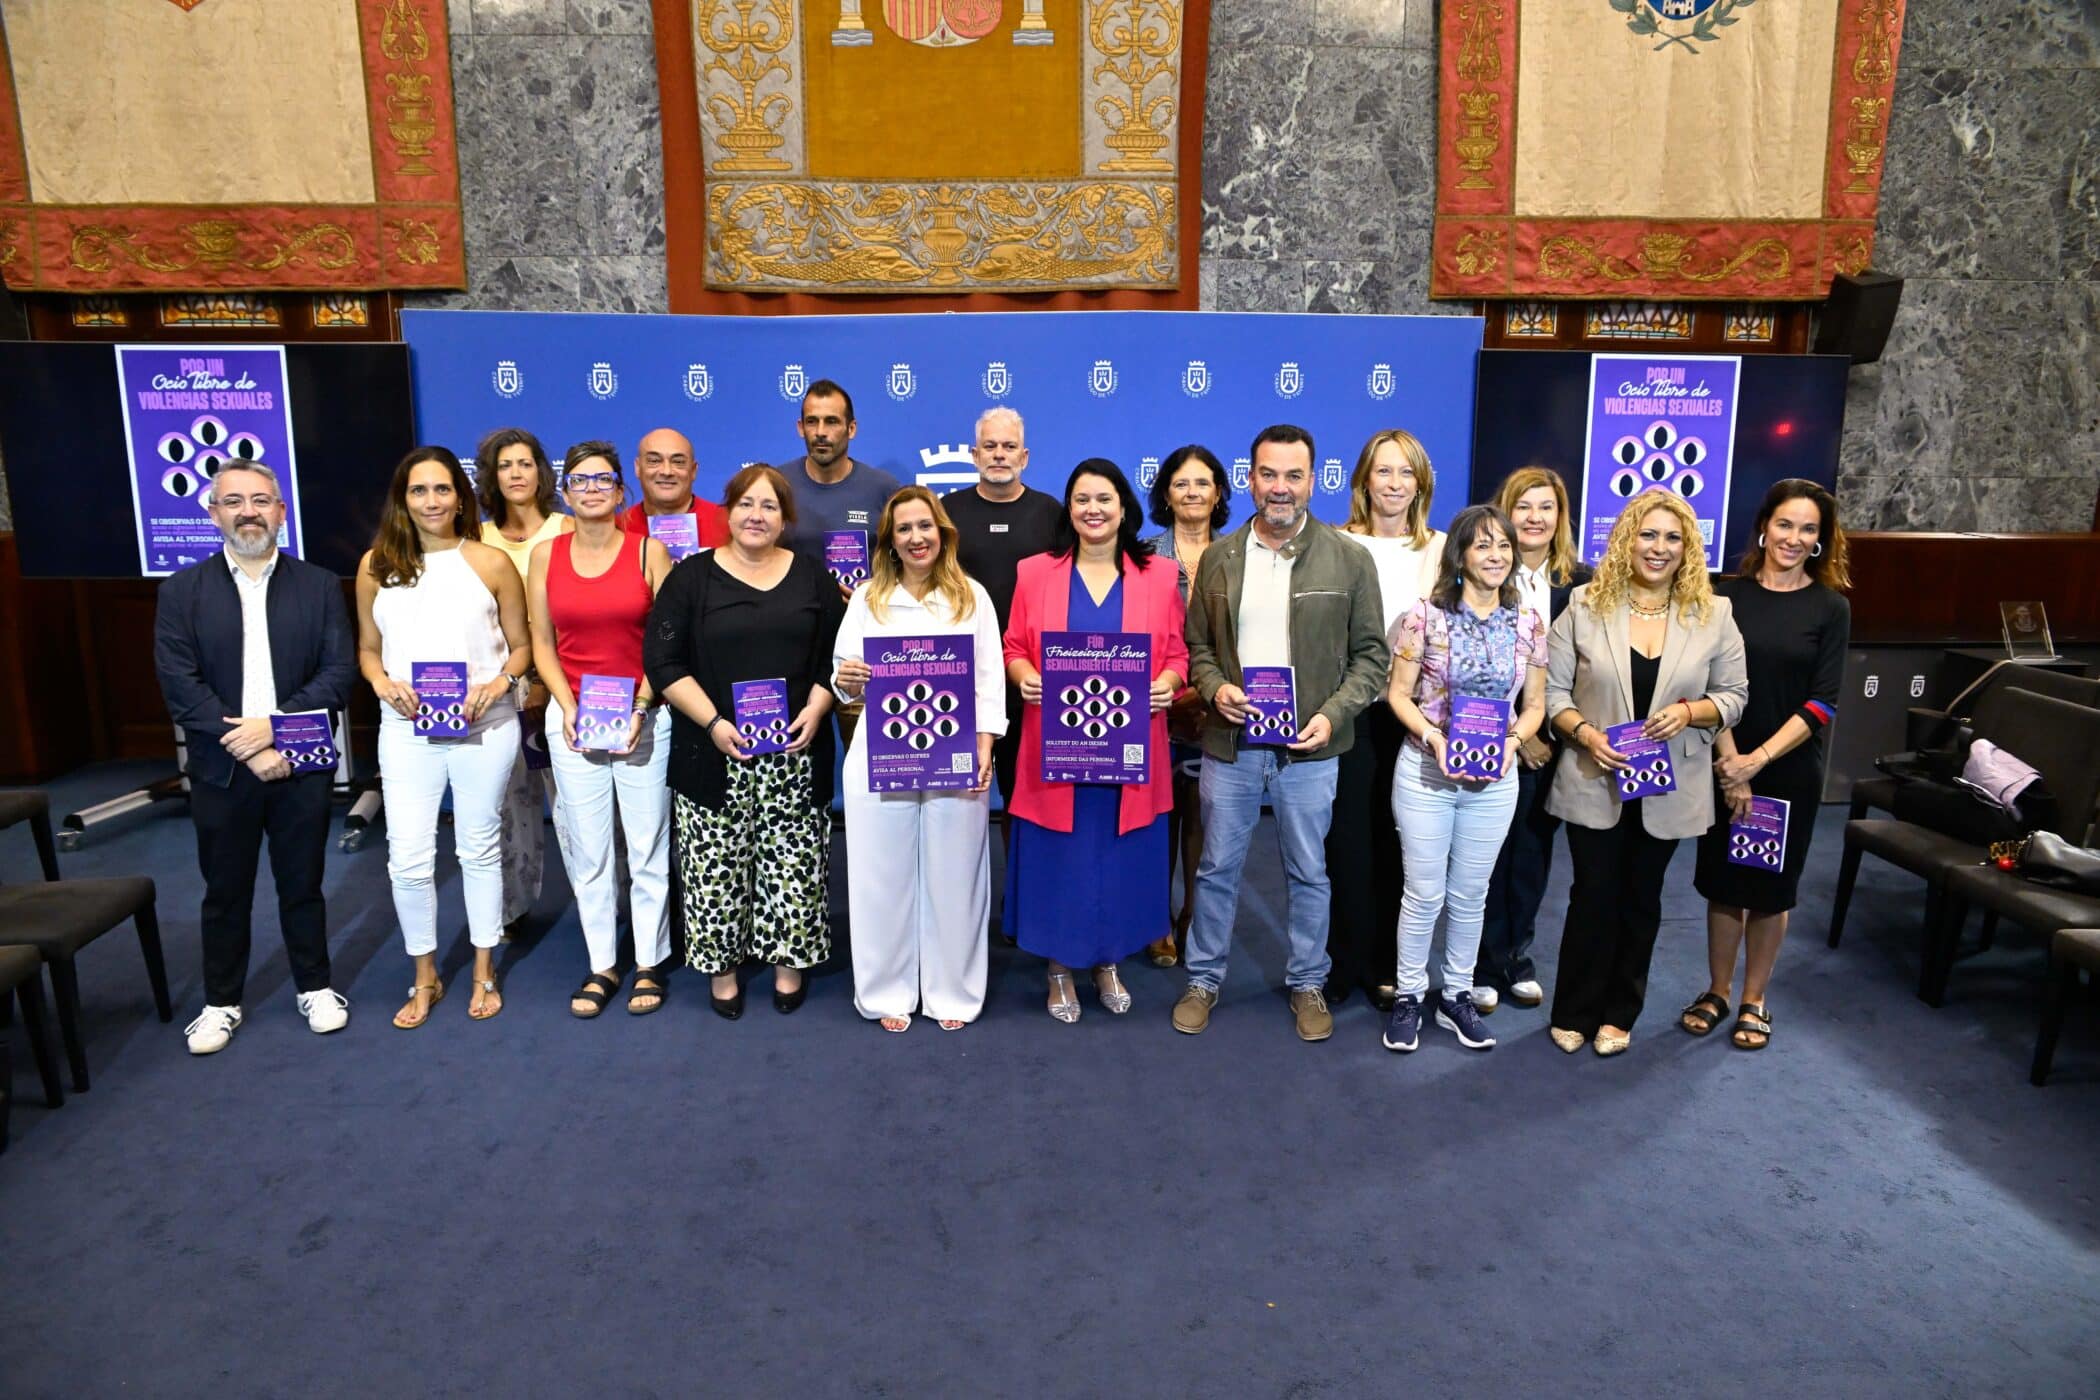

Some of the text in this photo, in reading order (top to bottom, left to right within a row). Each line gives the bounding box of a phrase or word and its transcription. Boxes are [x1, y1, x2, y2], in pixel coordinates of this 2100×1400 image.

[207, 358, 224, 376] UN
[152, 373, 187, 390] Ocio
[234, 371, 257, 390] de
[1670, 368, 1685, 384] UN
[1618, 381, 1650, 396] Ocio
[1691, 379, 1711, 397] de
[138, 391, 273, 410] VIOLENCIAS SEXUALES
[1604, 397, 1723, 416] VIOLENCIAS SEXUALES
[922, 640, 934, 652] UN
[881, 652, 907, 663] Ocio
[940, 648, 956, 661] de
[871, 662, 967, 677] VIOLENCIAS SEXUALES
[1045, 659, 1146, 672] SEXUALISIERTE GEWALT
